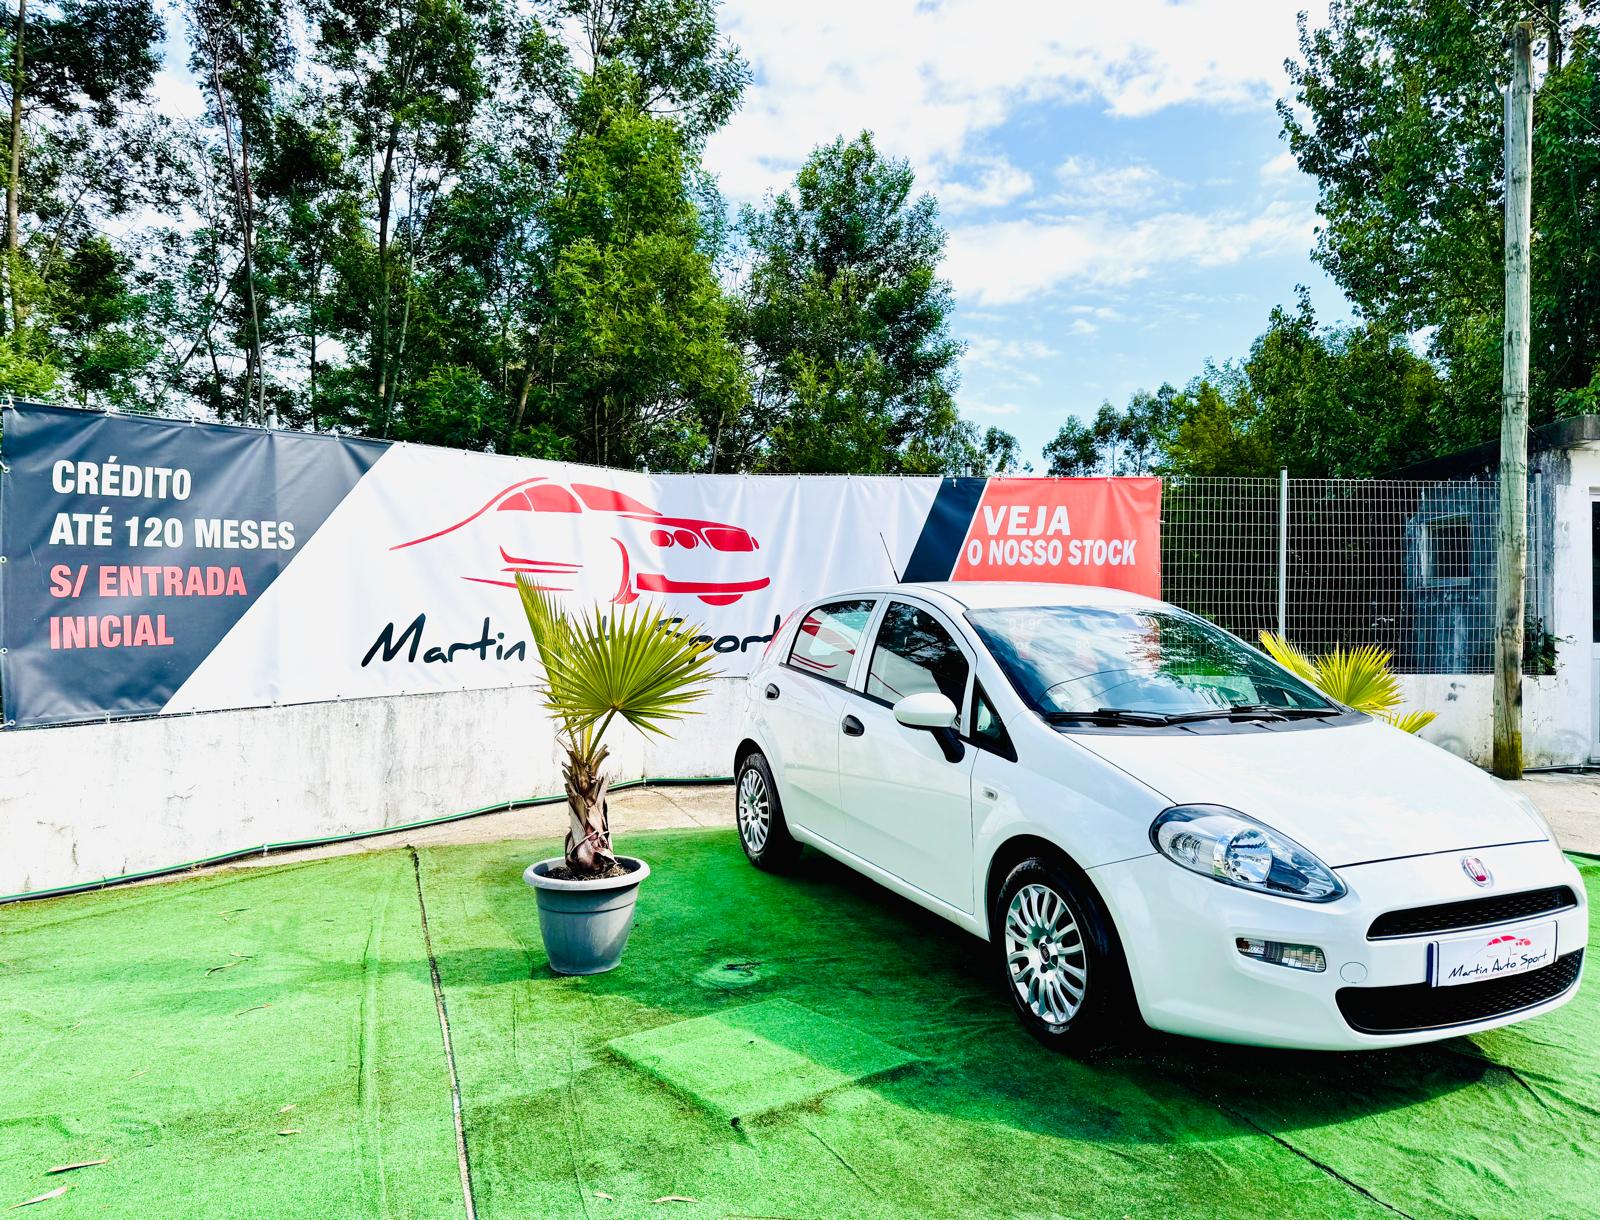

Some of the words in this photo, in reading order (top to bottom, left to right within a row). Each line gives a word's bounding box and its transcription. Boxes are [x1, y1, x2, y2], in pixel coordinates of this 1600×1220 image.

[52, 455, 192, 501] CRÉDITO
[48, 507, 113, 546] ATÉ
[125, 516, 183, 548] 120
[194, 518, 296, 551] MESES
[983, 505, 1071, 536] VEJA
[967, 539, 983, 566] O
[988, 539, 1063, 566] NOSSO
[1068, 539, 1137, 566] STOCK
[49, 564, 89, 598] S/
[99, 565, 248, 597] ENTRADA
[49, 614, 174, 650] INICIAL
[361, 612, 526, 667] Martin
[1448, 963, 1488, 979] Martin
[1492, 957, 1516, 973] Auto
[1520, 948, 1548, 970] Sport
